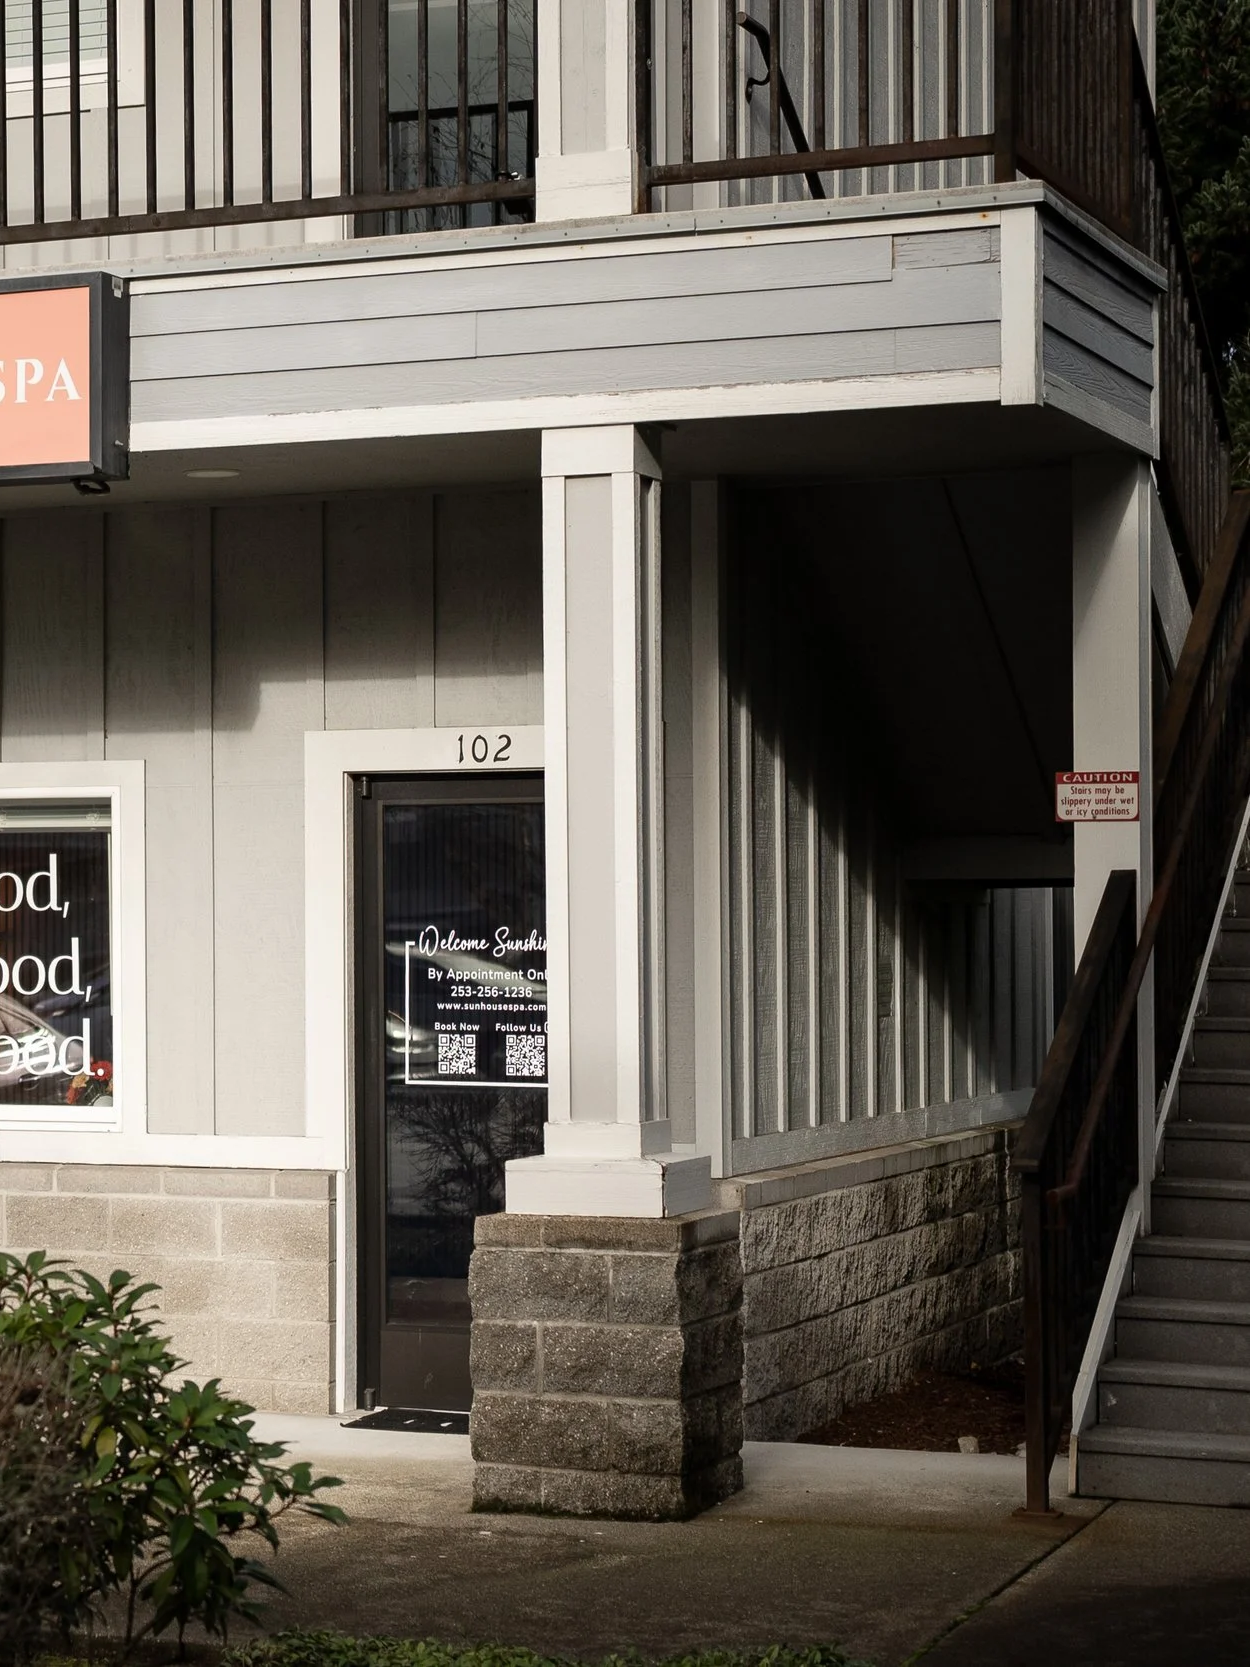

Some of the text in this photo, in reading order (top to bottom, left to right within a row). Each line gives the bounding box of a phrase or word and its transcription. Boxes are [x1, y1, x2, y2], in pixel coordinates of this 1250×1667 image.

[453, 734, 490, 763] 102
[1063, 773, 1132, 782] CAUTION
[1071, 785, 1124, 796] Stairs may be
[1061, 797, 1091, 806] slippery
[1095, 797, 1116, 805] under
[1077, 809, 1087, 817] icy
[1091, 807, 1129, 815] conditions
[418, 925, 489, 956] Welcome
[428, 968, 443, 981] By
[447, 968, 523, 982] Appointment
[451, 986, 532, 997] 253-256-1236
[437, 1002, 546, 1011] www.sunhousespa.com
[435, 1022, 541, 1032] Book Now Follow Us
